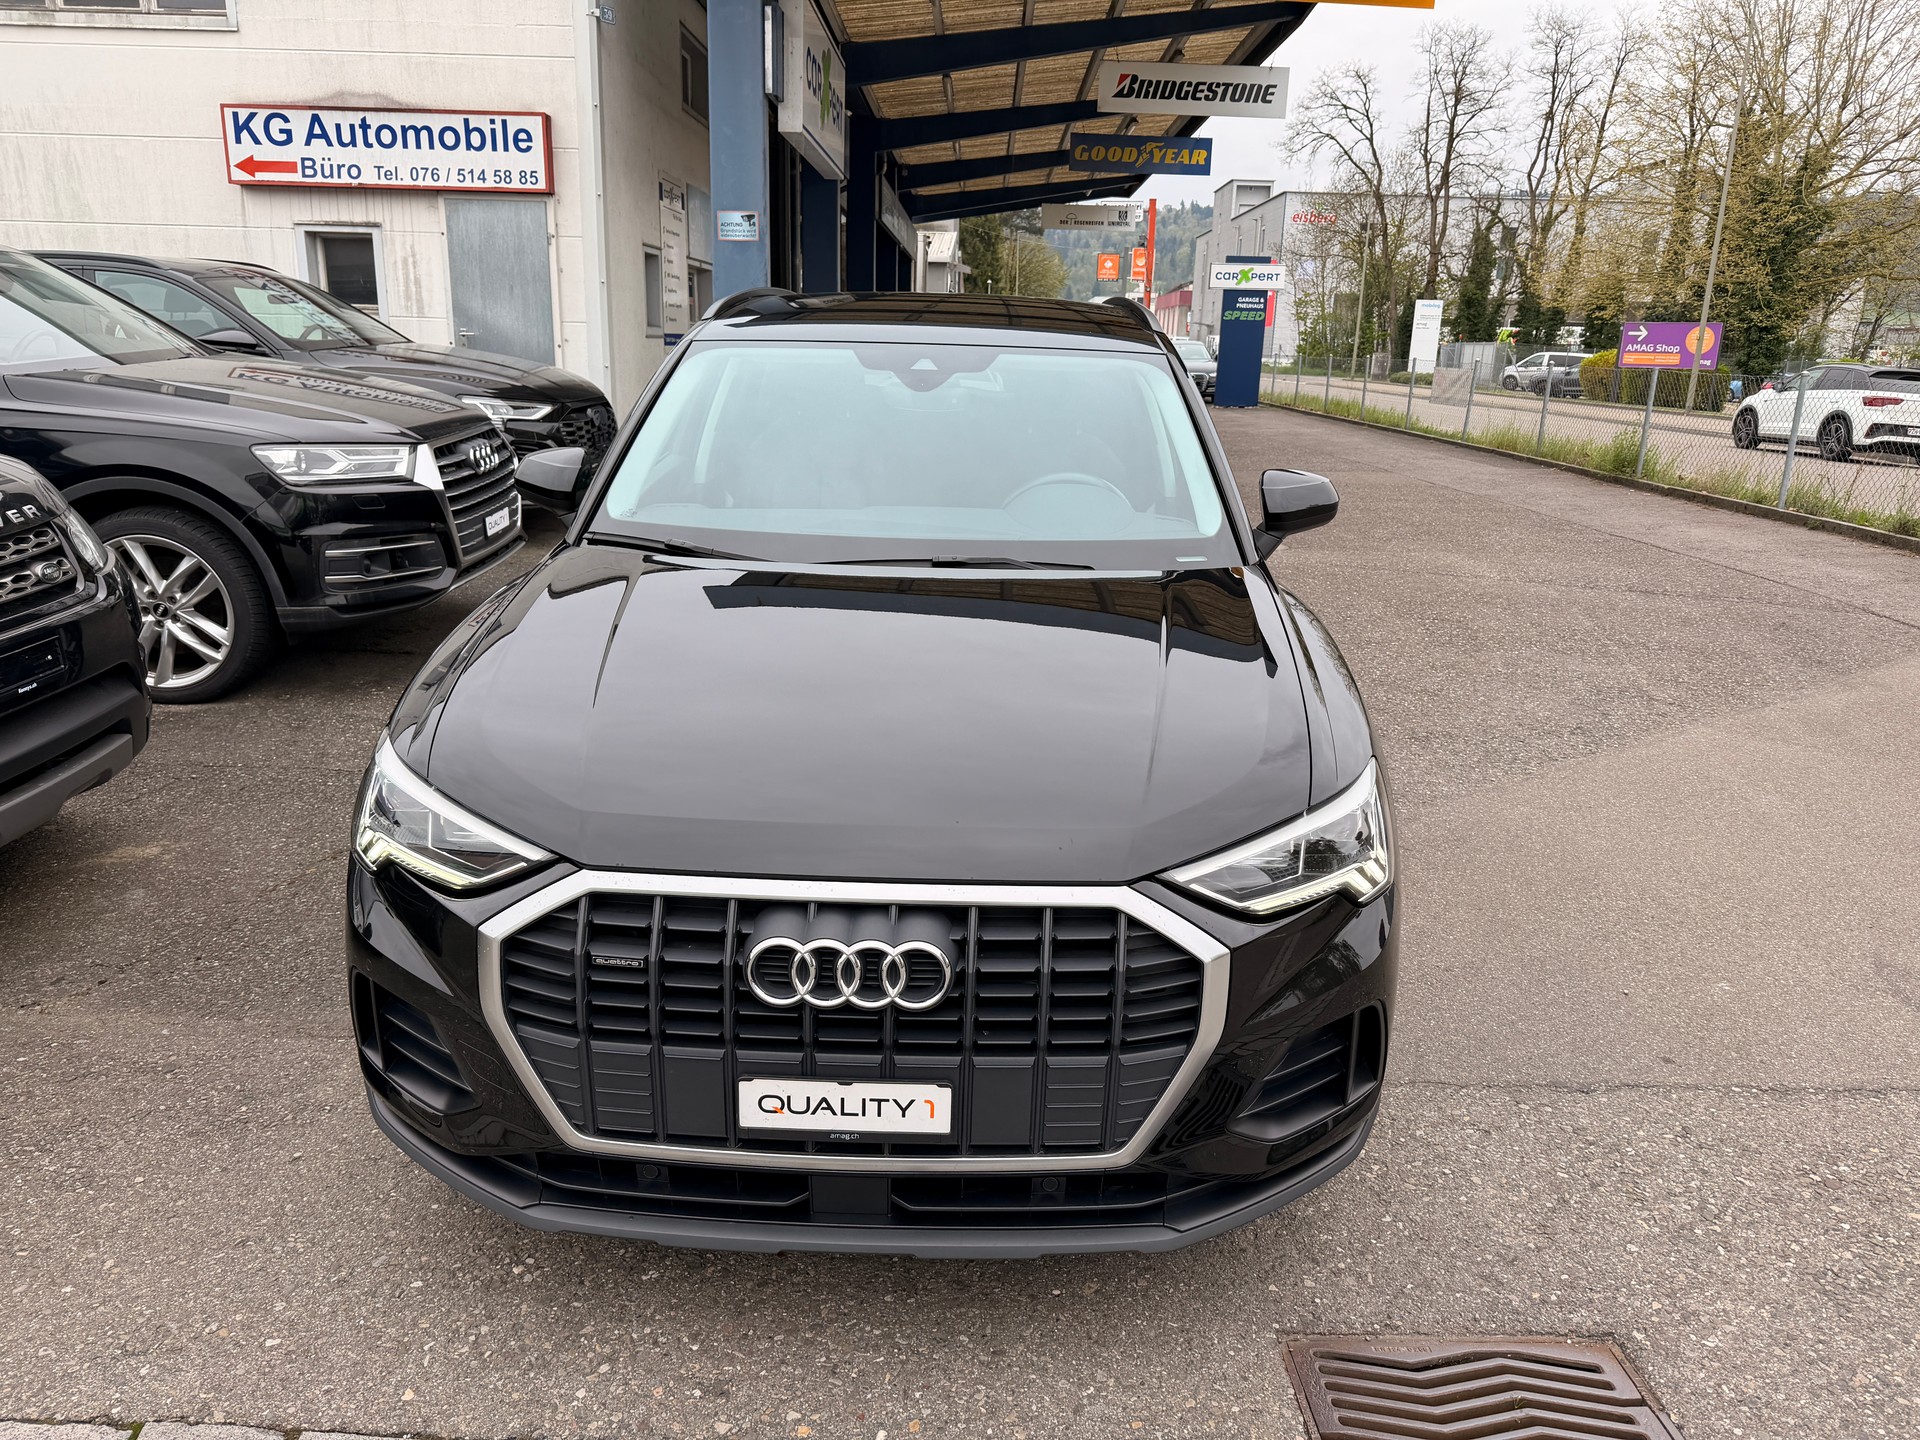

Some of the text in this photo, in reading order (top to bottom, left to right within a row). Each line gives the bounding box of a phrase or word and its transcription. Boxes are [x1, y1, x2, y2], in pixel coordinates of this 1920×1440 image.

[1112, 73, 1277, 104] BRIDGESTONE
[231, 111, 534, 152] KG Automobile
[300, 156, 539, 186] Büro Tel. 076 / 514 58 85
[1223, 310, 1265, 321] SPEED
[1625, 344, 1680, 353] AMAG Shop
[595, 958, 639, 966] quattro
[757, 1094, 935, 1119] QUALITY 1
